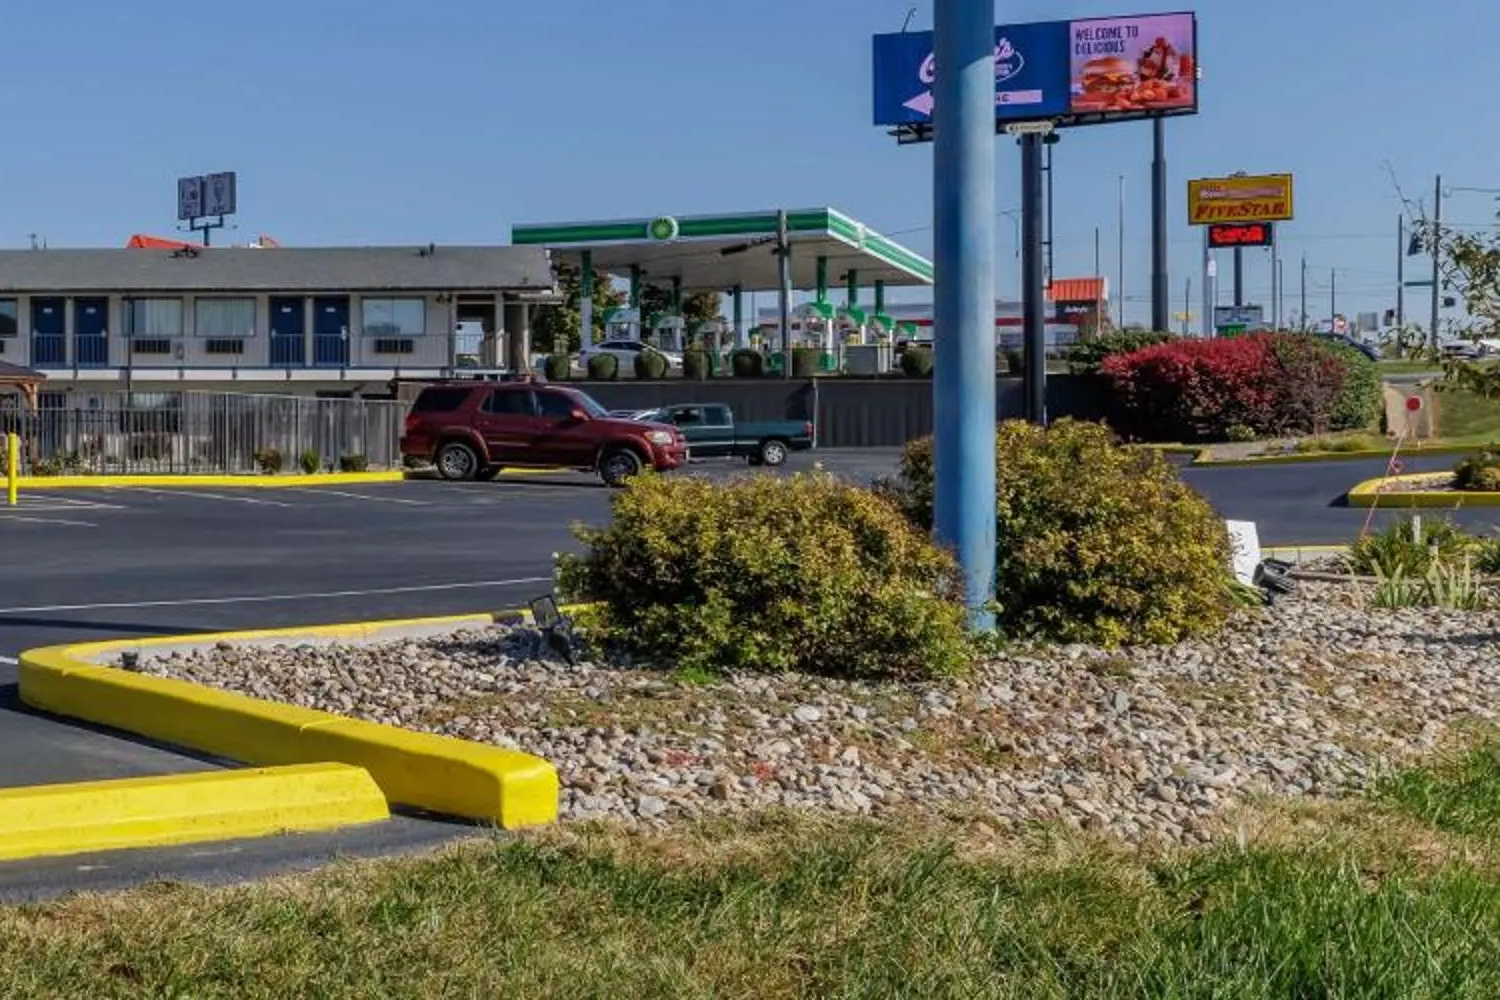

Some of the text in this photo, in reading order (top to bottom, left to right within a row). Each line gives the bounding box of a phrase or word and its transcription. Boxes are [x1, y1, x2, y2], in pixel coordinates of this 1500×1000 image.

[1075, 25, 1139, 41] WELCOME TO
[1075, 40, 1125, 55] DELICIOUS
